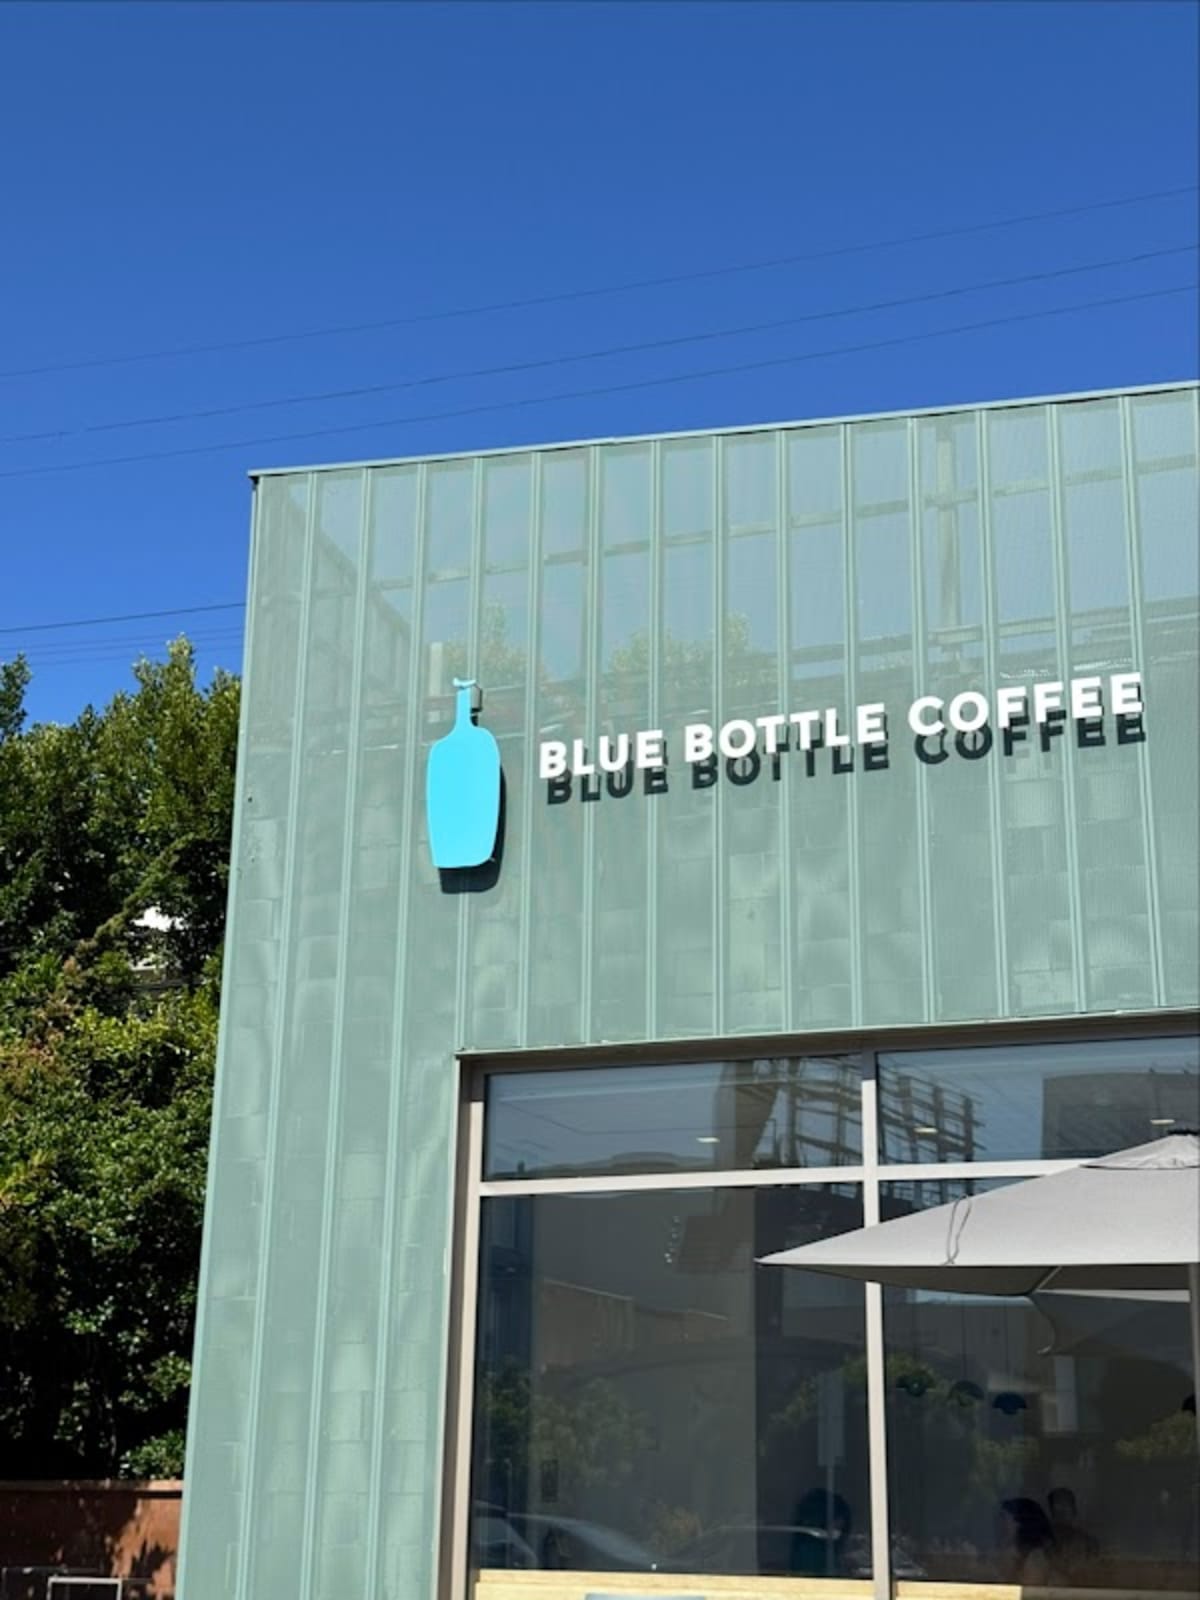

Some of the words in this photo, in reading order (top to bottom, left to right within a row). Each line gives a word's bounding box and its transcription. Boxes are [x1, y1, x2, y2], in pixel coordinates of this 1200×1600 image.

[538, 729, 664, 779] BLUE
[684, 703, 886, 763] BOTTLE
[907, 672, 1143, 735] COFFEE
